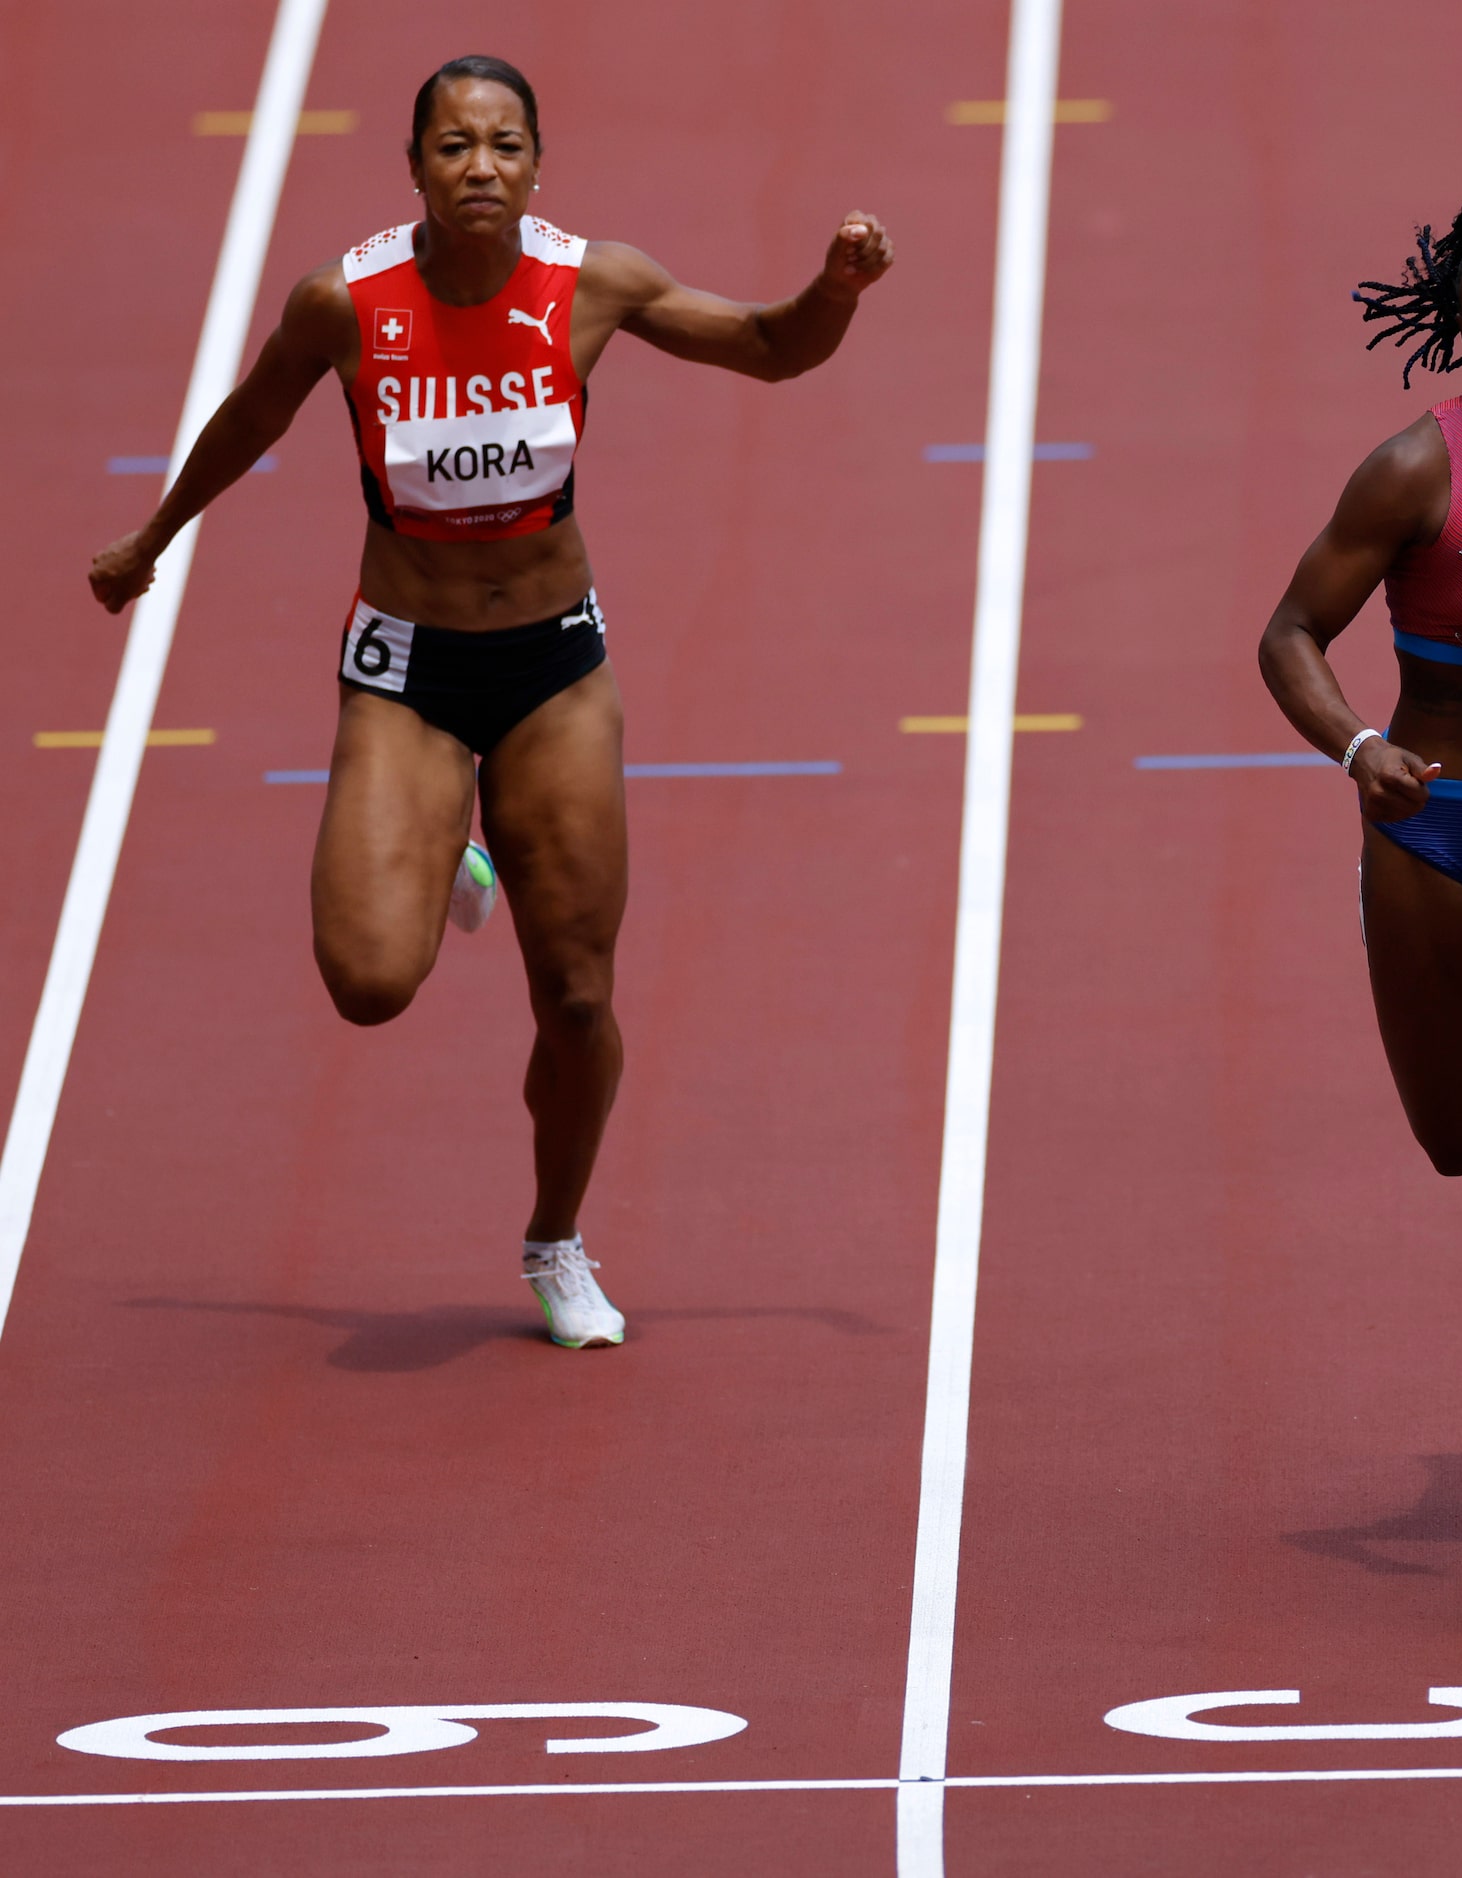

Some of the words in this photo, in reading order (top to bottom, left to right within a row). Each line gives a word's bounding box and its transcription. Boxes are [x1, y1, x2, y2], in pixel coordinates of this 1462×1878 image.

[376, 366, 554, 425] SUISSE
[427, 439, 535, 483] KORA
[353, 617, 391, 677] 6
[56, 1702, 748, 1761] 6
